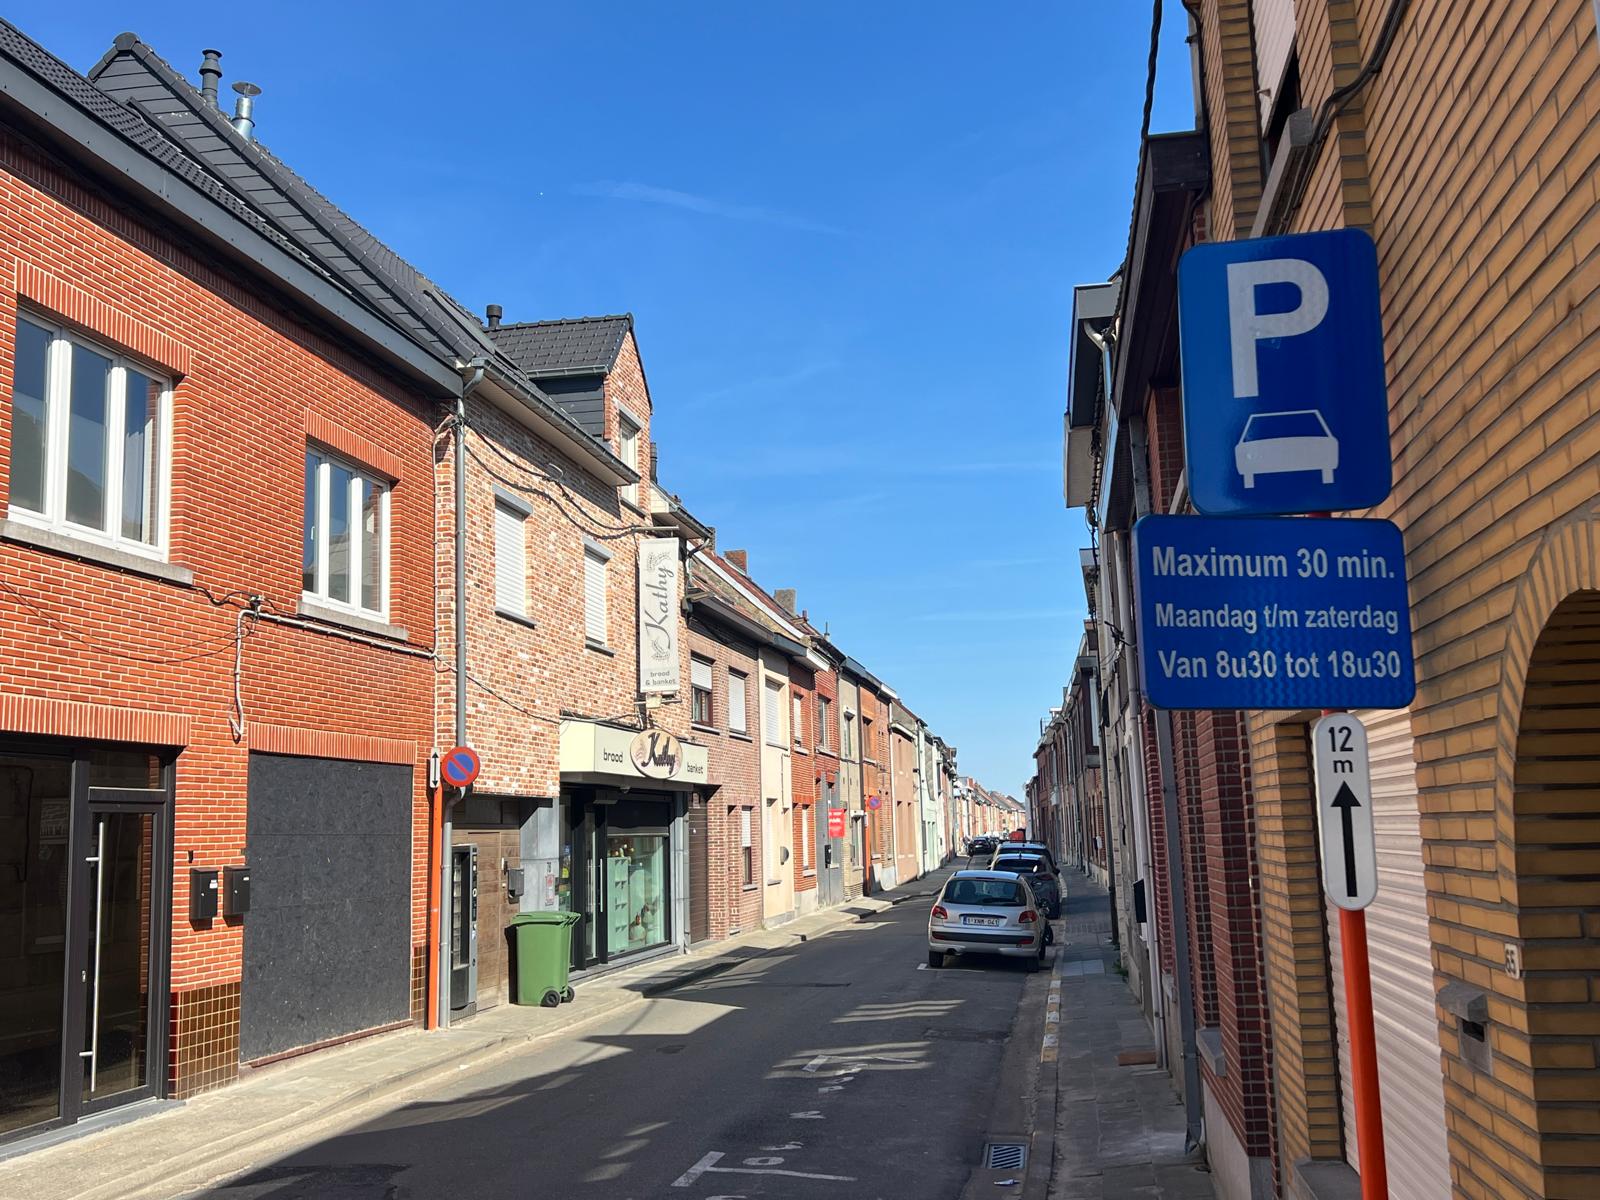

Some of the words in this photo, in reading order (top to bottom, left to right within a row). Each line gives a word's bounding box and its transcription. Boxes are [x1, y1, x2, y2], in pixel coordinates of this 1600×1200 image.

[1226, 258, 1330, 399] P
[1152, 547, 1287, 578] Maximum
[1296, 547, 1328, 579] 30
[1337, 547, 1396, 579] min.
[645, 565, 674, 649] Kathy
[1155, 602, 1257, 634] Maandag
[1264, 603, 1299, 628] t/m
[1304, 604, 1399, 635] zaterdag
[650, 670, 671, 678] brood
[1158, 650, 1208, 679] Van
[1216, 650, 1277, 679] 8u30
[1284, 651, 1321, 679] tot
[1327, 650, 1401, 679] 18u30
[652, 678, 677, 686] banket
[1327, 726, 1354, 752] 12
[603, 747, 624, 764] brood
[641, 733, 675, 775] Kathy
[1332, 759, 1353, 774] m
[686, 761, 704, 775] banket
